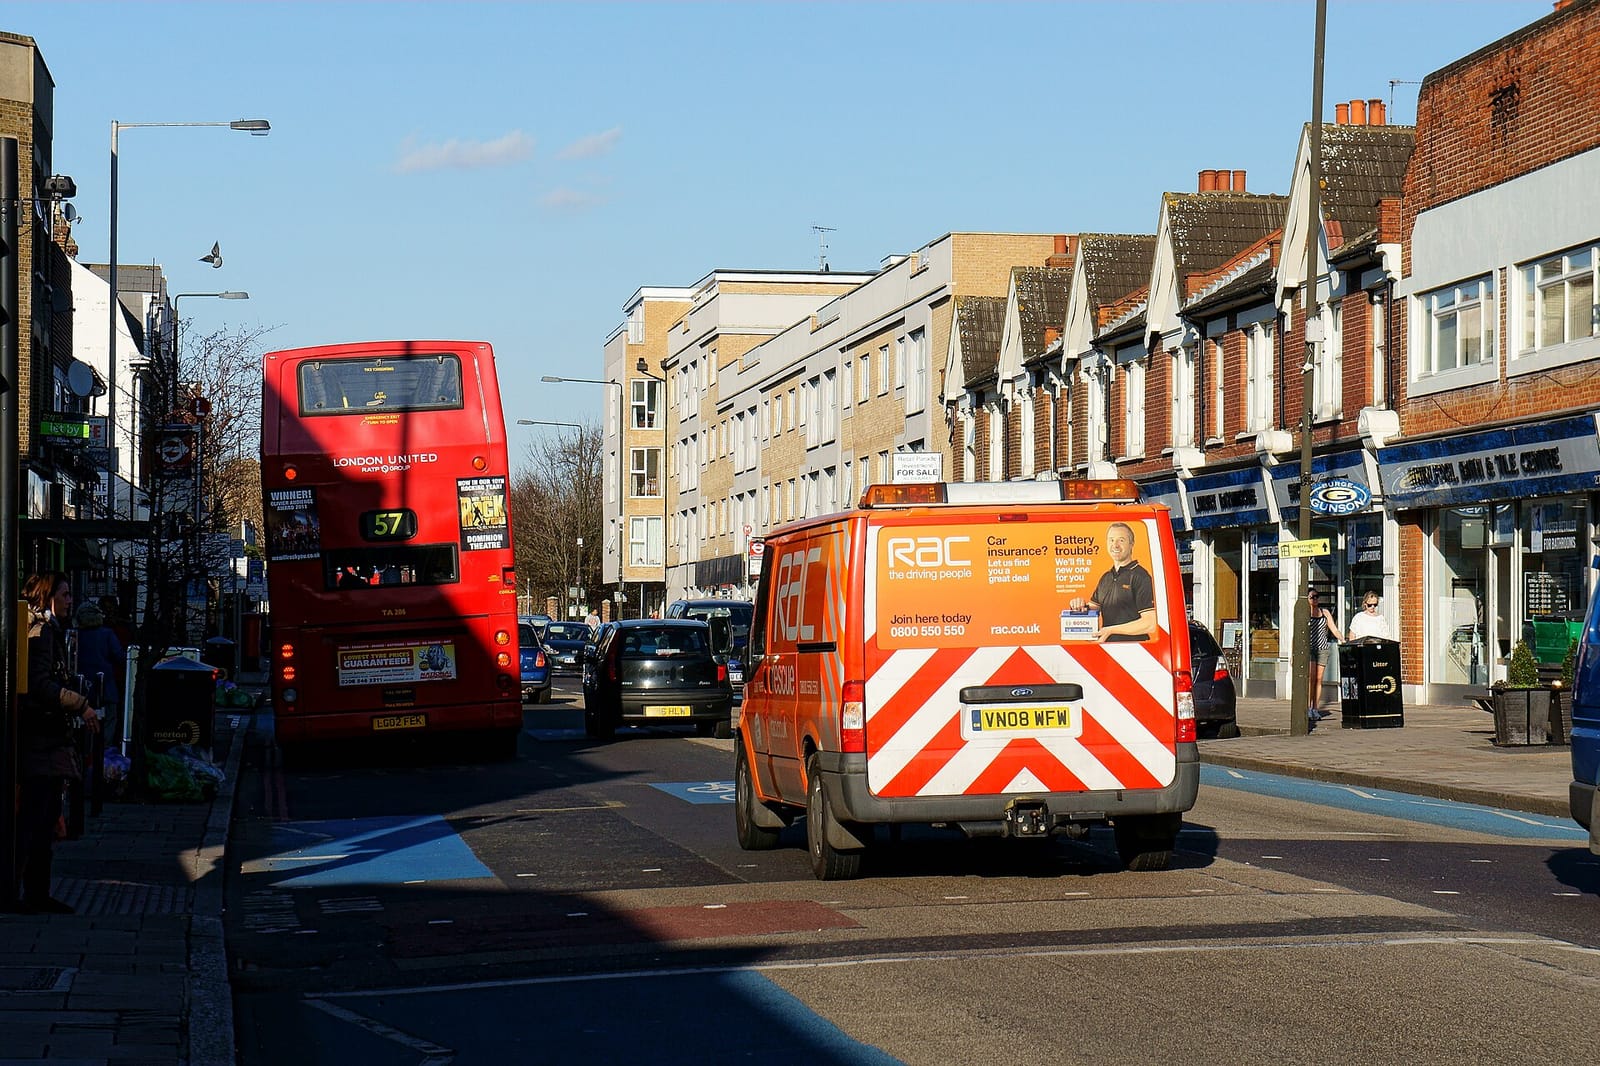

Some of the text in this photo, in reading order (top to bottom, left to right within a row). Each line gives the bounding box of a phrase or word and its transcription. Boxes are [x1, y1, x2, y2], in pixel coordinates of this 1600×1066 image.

[196, 399, 205, 416] L
[67, 423, 80, 435] by
[333, 453, 438, 467] LONDON UNITED
[461, 484, 485, 492] ROCKING
[1321, 481, 1354, 489] BURGE
[270, 489, 312, 501] WINNER!
[1322, 489, 1352, 501] G
[1310, 498, 1364, 513] GUNSON
[373, 512, 403, 536] 57
[467, 534, 503, 543] DOMINION
[987, 535, 1007, 546] Car
[1054, 535, 1095, 547] Battery
[469, 541, 503, 550] THEATRE
[987, 545, 1048, 557] insurance?
[1055, 545, 1100, 556] trouble?
[988, 559, 1002, 567] Let
[1013, 558, 1030, 566] find
[1055, 557, 1075, 566] We'll
[1076, 557, 1086, 566] fit
[889, 568, 972, 581] the driving people
[988, 568, 1003, 576] you
[989, 574, 1030, 584] great deal
[1056, 574, 1085, 583] for you
[890, 613, 972, 625] Join here today
[890, 625, 965, 638] 0800 550 550
[990, 623, 1041, 635] rac.co.uk
[343, 657, 411, 669] GUARANTEED!
[1372, 661, 1389, 669] Litter
[771, 664, 795, 696] rescue
[985, 710, 1067, 728] VN08 WFW
[153, 731, 188, 739] merton
